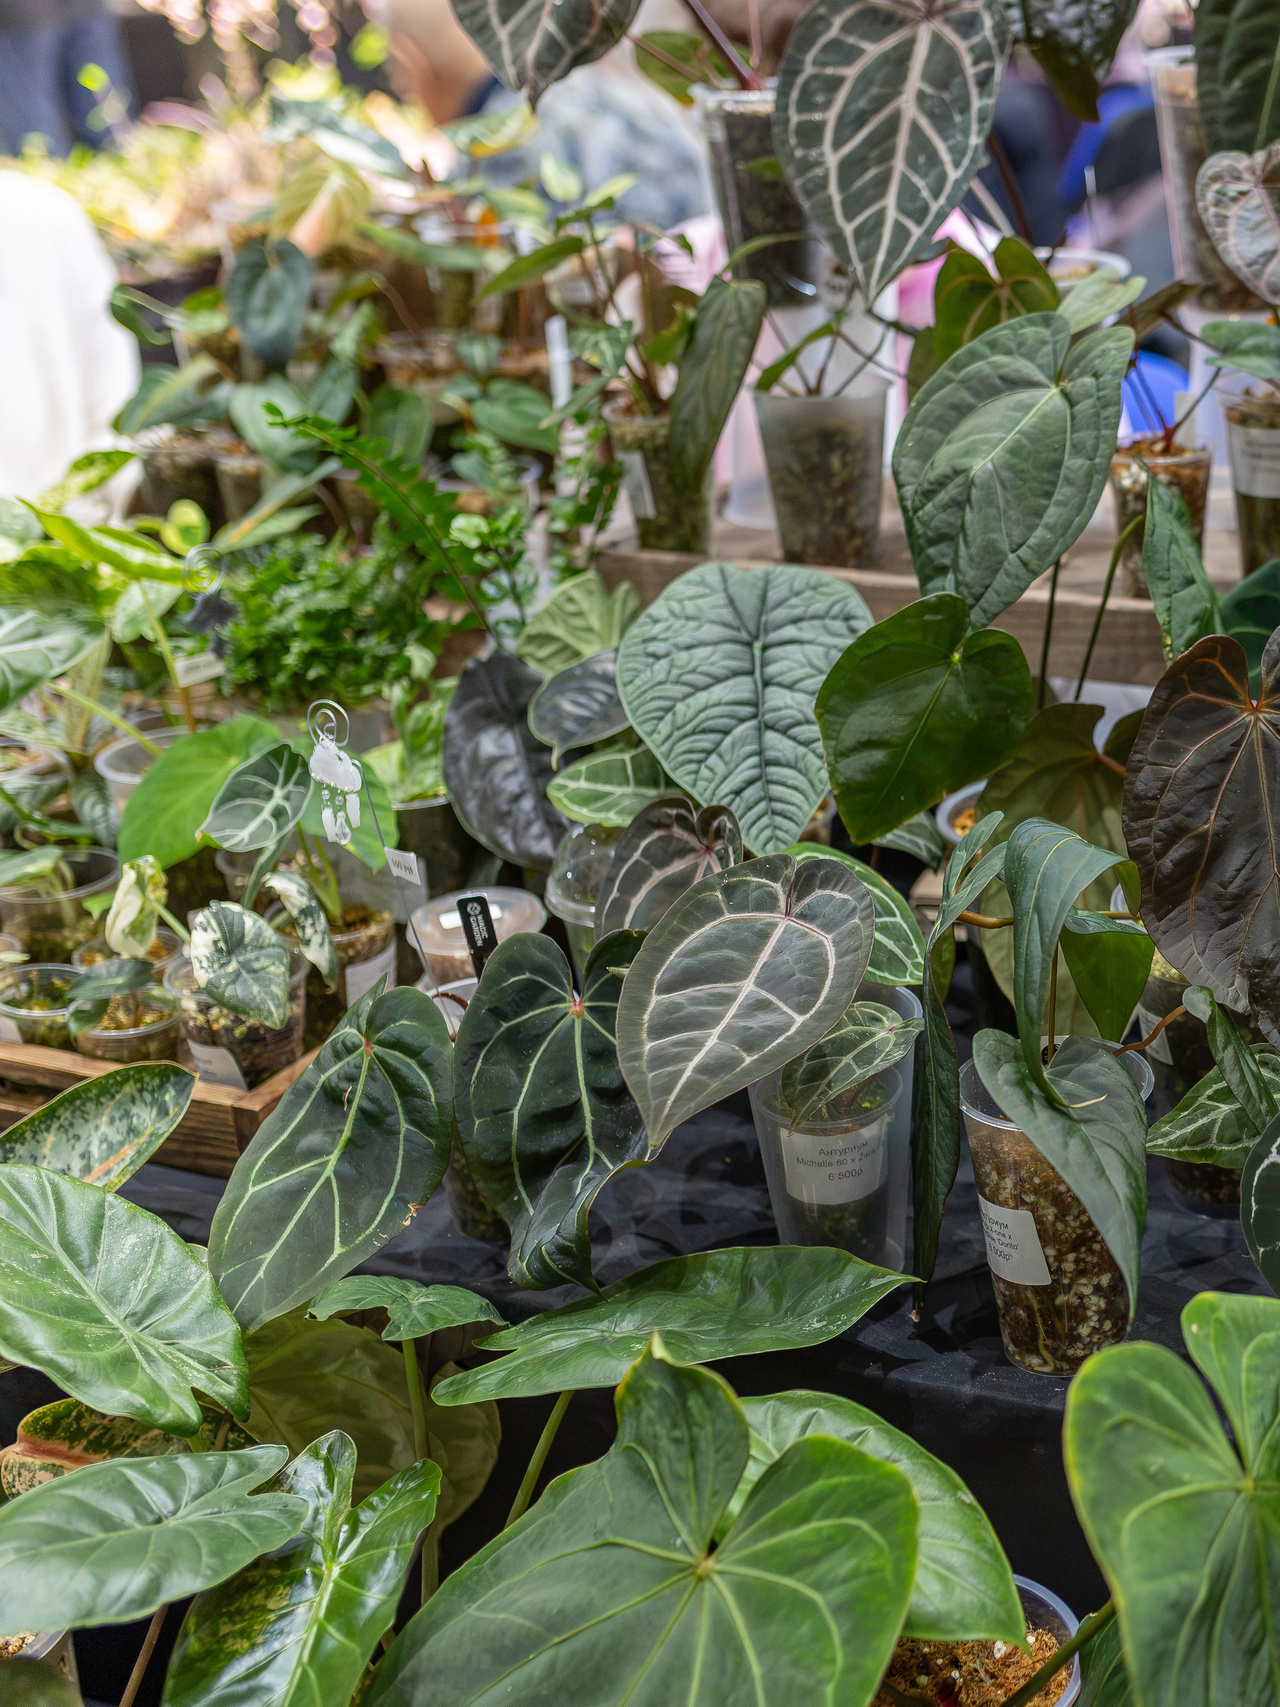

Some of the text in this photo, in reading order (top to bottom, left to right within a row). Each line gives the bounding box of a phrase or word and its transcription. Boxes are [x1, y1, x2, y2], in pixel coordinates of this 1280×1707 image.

[469, 915, 484, 947] GARDEN
[818, 1141, 868, 1158] Антуриум
[828, 1172, 835, 1181] 6
